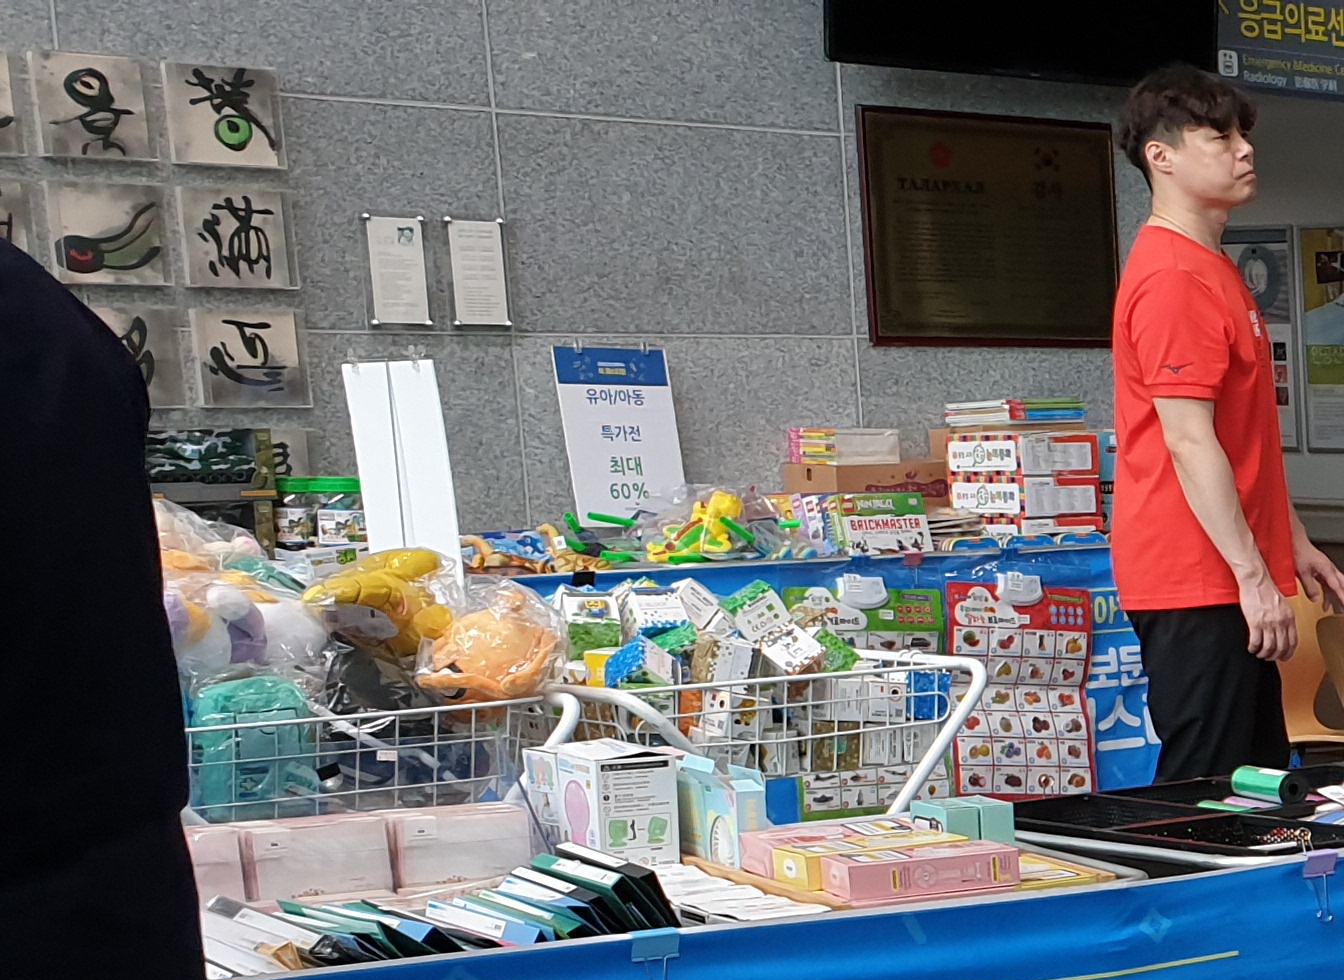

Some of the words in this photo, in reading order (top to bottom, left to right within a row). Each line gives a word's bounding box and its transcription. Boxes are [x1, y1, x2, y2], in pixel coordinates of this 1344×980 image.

[1243, 70, 1287, 88] Radiology
[585, 388, 645, 406] 유아/아동
[600, 425, 642, 442] 특가전
[609, 456, 643, 476] 최대
[609, 482, 649, 500] 60%
[850, 517, 921, 532] BRICKMASTER
